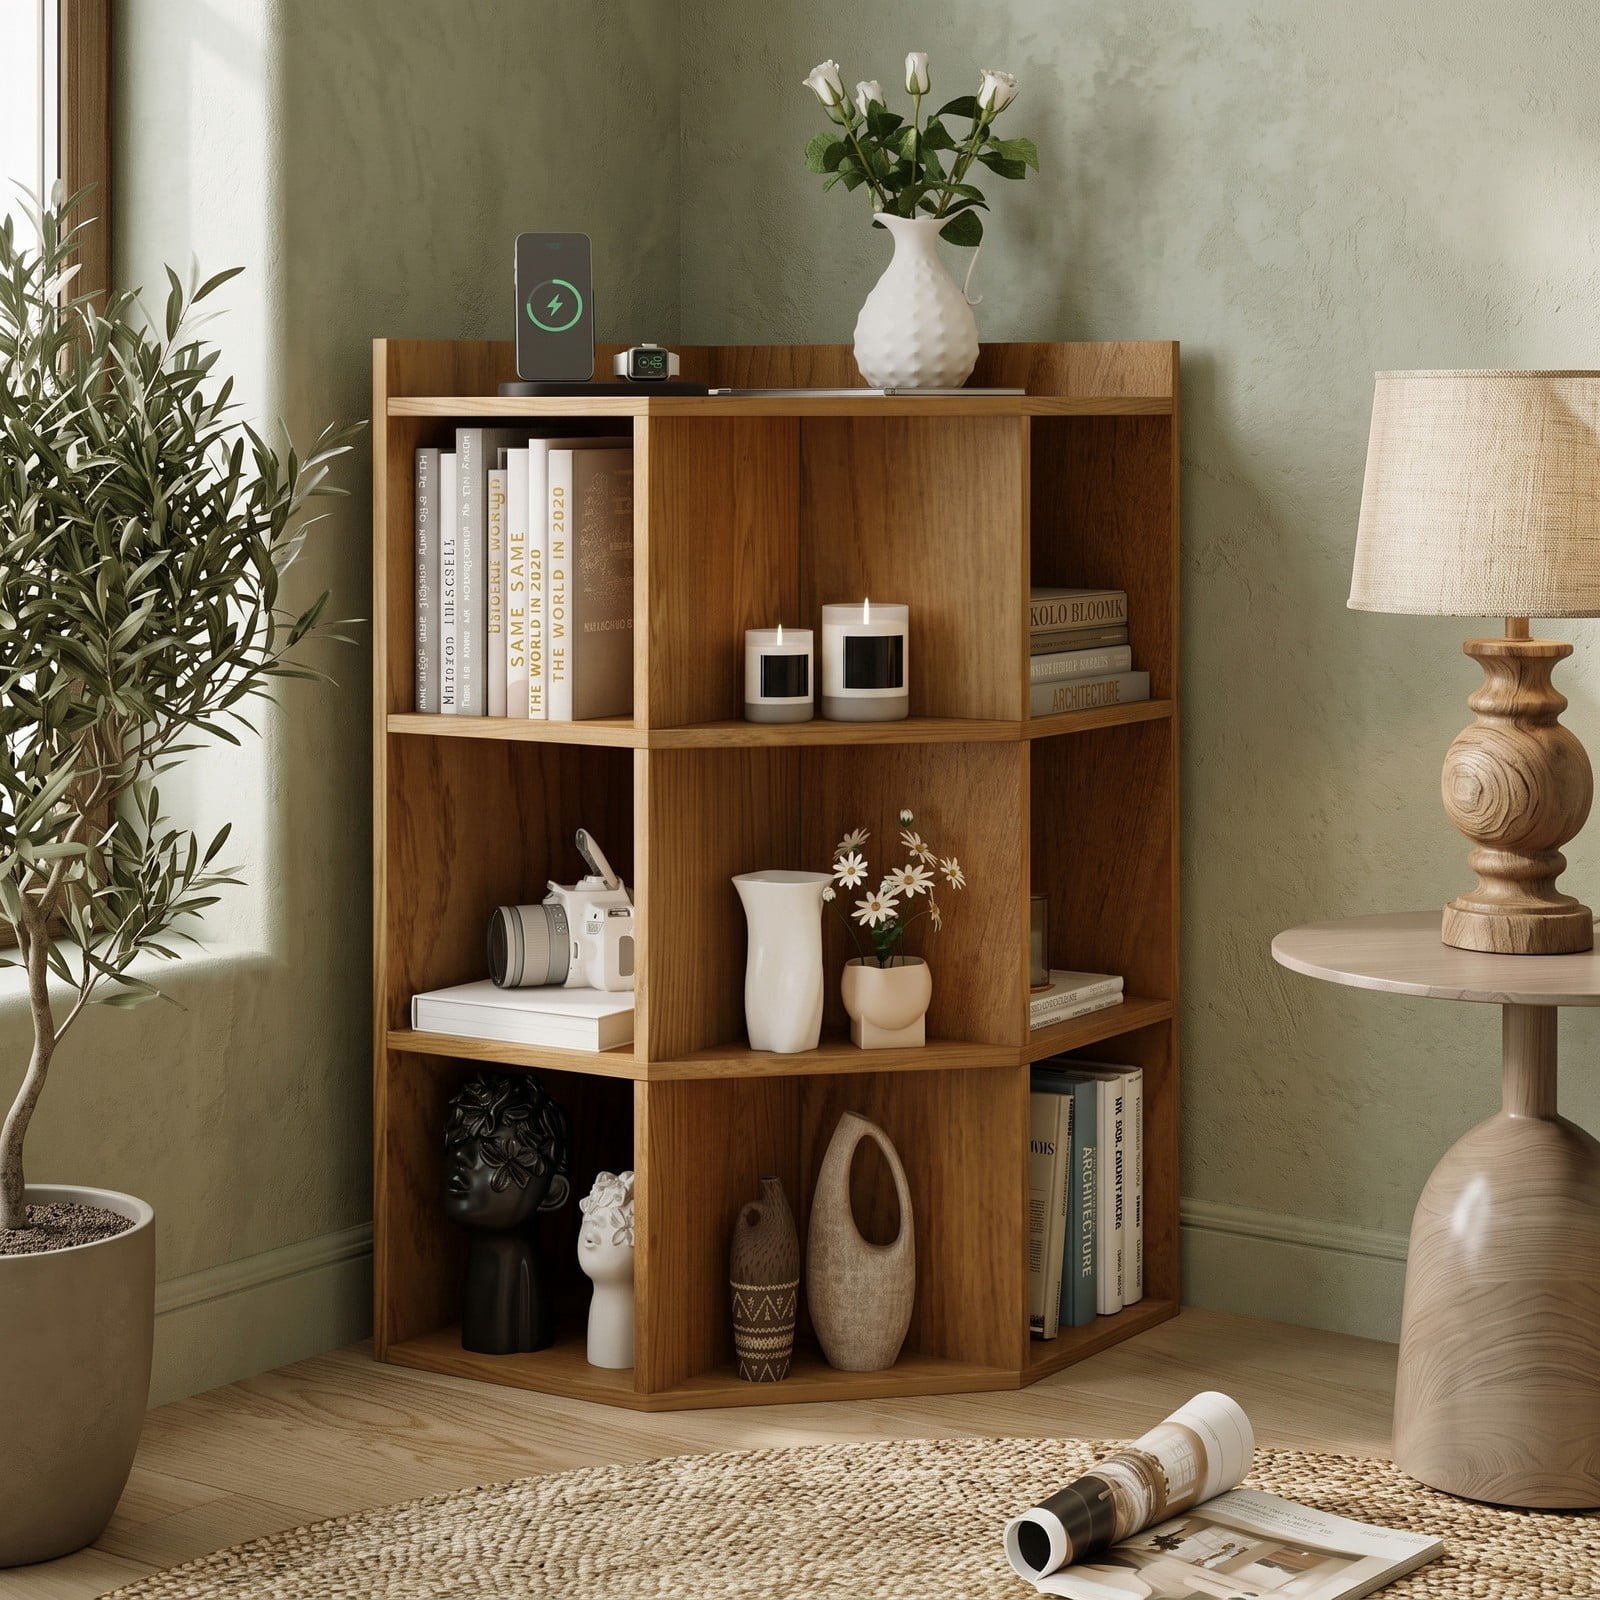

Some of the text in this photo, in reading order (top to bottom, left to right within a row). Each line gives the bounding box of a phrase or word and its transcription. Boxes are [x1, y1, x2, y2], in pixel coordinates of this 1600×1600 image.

[510, 531, 525, 668] SAME SAME
[530, 549, 542, 714] THE WORLD IN 2020
[552, 487, 565, 682] THE WORLD IN 2020
[1072, 599, 1124, 622] BLOOMK
[1052, 680, 1120, 712] ARCHITECTURE
[1081, 1146, 1093, 1278] ARCHITECTURE
